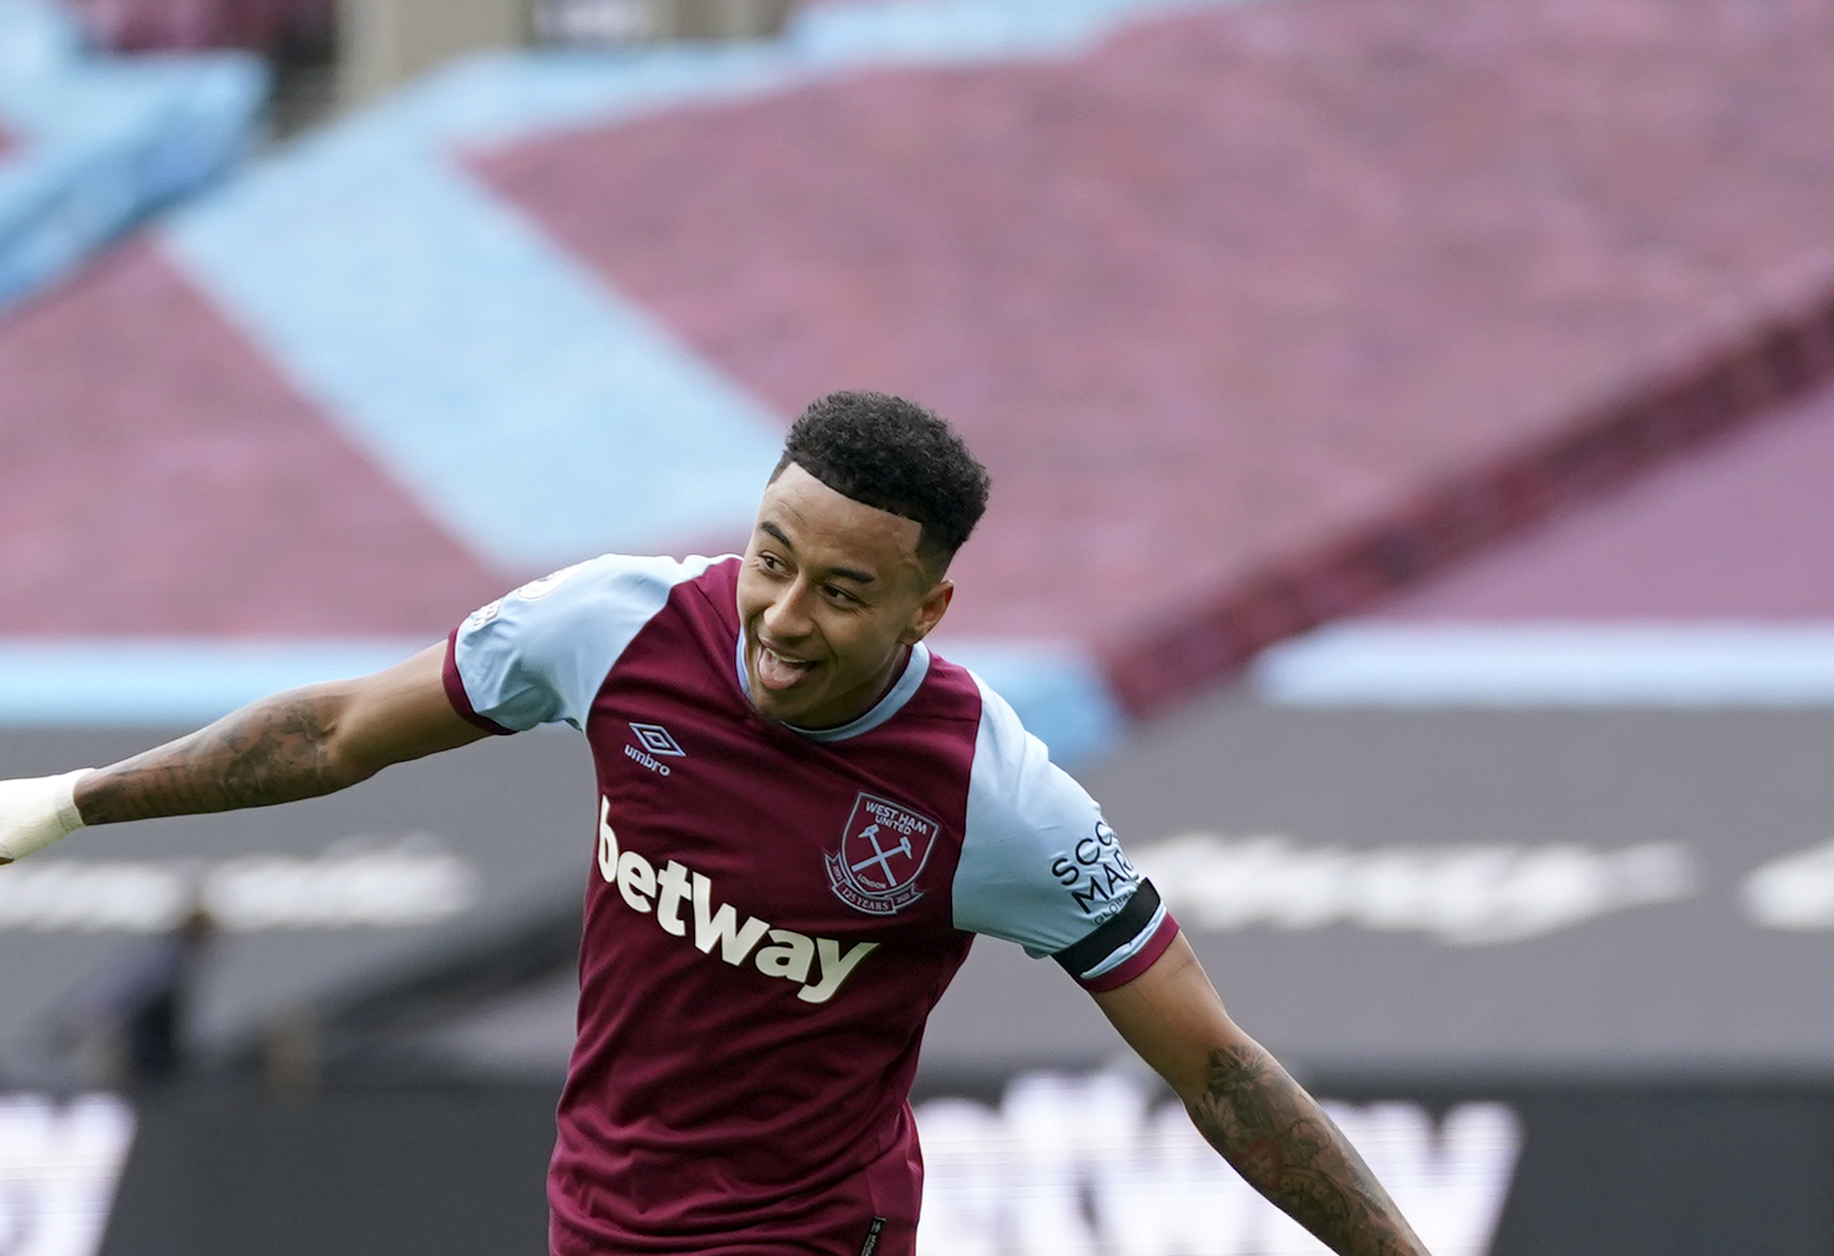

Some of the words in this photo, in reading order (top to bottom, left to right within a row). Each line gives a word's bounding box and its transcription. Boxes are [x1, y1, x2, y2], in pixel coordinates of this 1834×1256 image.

[624, 744, 671, 776] umbro
[865, 801, 899, 819] WEST
[898, 814, 927, 835] HAM
[874, 814, 912, 835] UNITED
[1051, 821, 1116, 886] SCO
[857, 873, 886, 890] LONDON
[1071, 850, 1135, 914] MAR
[598, 794, 880, 1003] betway
[841, 887, 857, 900] 125
[856, 896, 889, 911] YEARS
